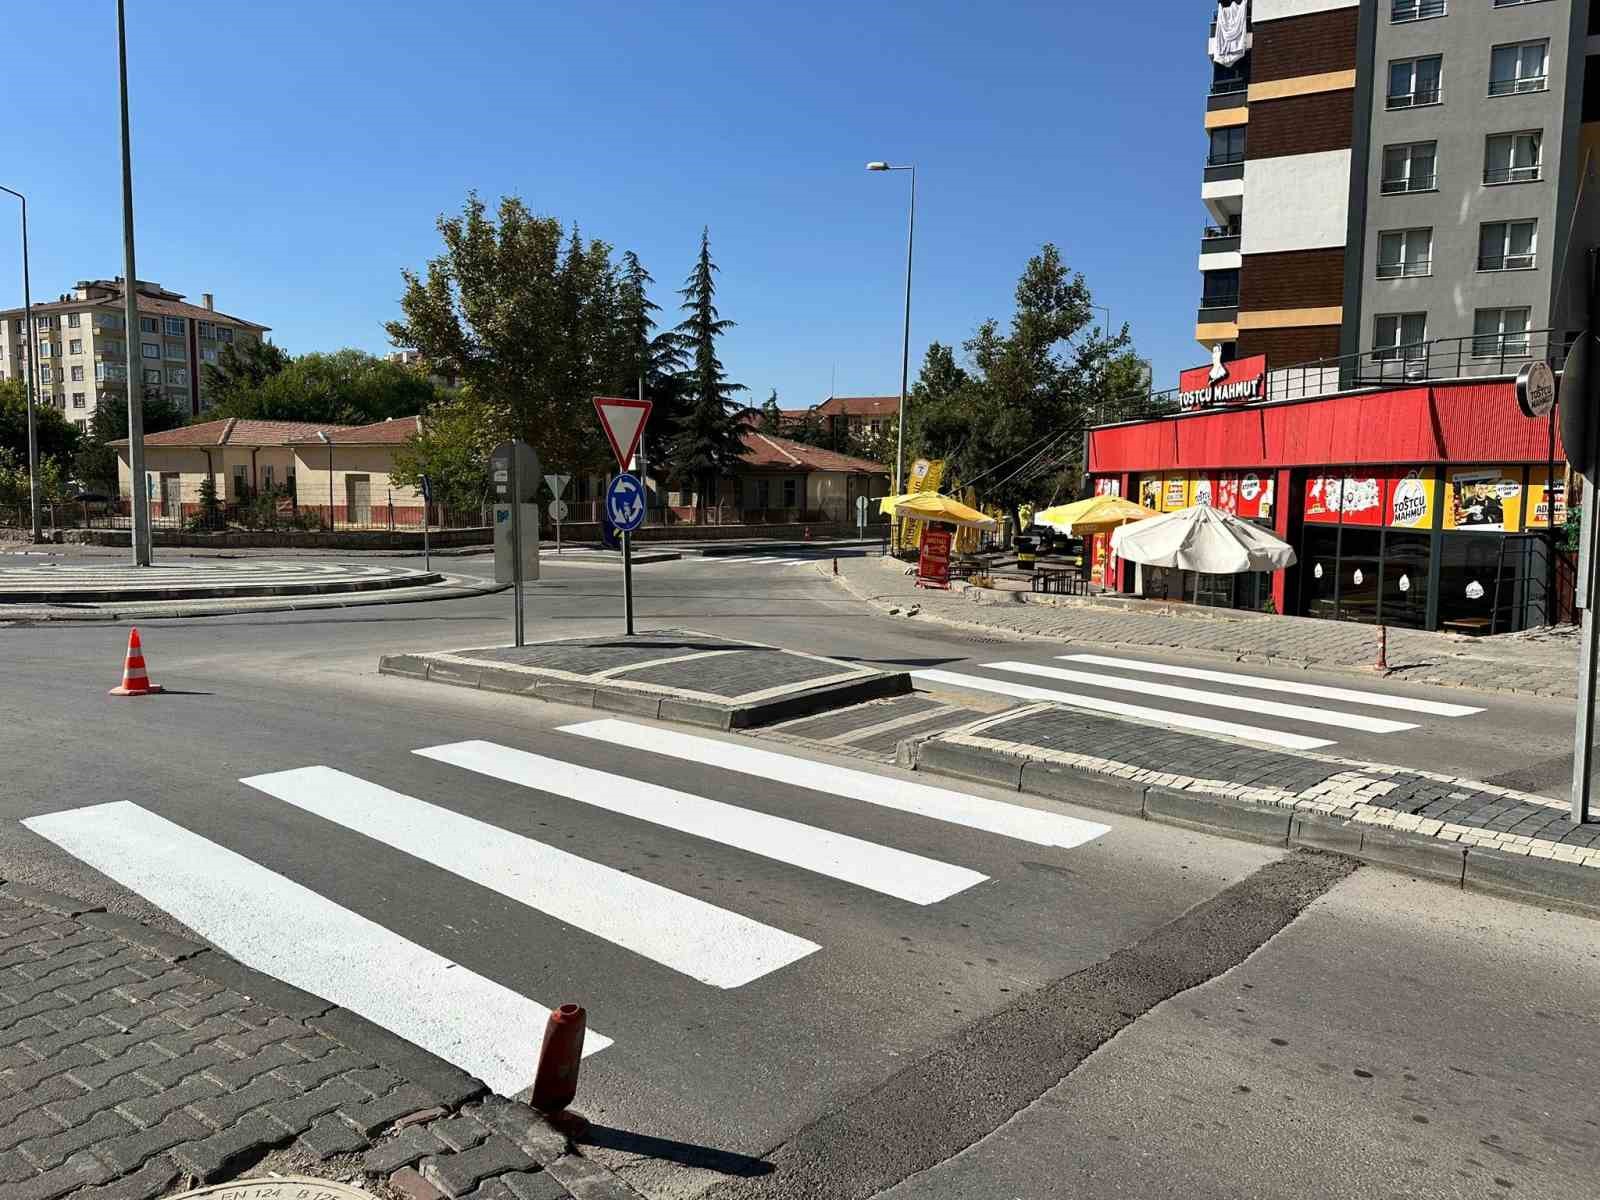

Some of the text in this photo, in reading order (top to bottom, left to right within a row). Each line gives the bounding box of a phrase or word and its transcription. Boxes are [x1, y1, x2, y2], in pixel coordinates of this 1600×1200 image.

[1214, 380, 1258, 400] MAHMUT
[1395, 504, 1427, 522] MAHMUT
[256, 1188, 281, 1198] 124
